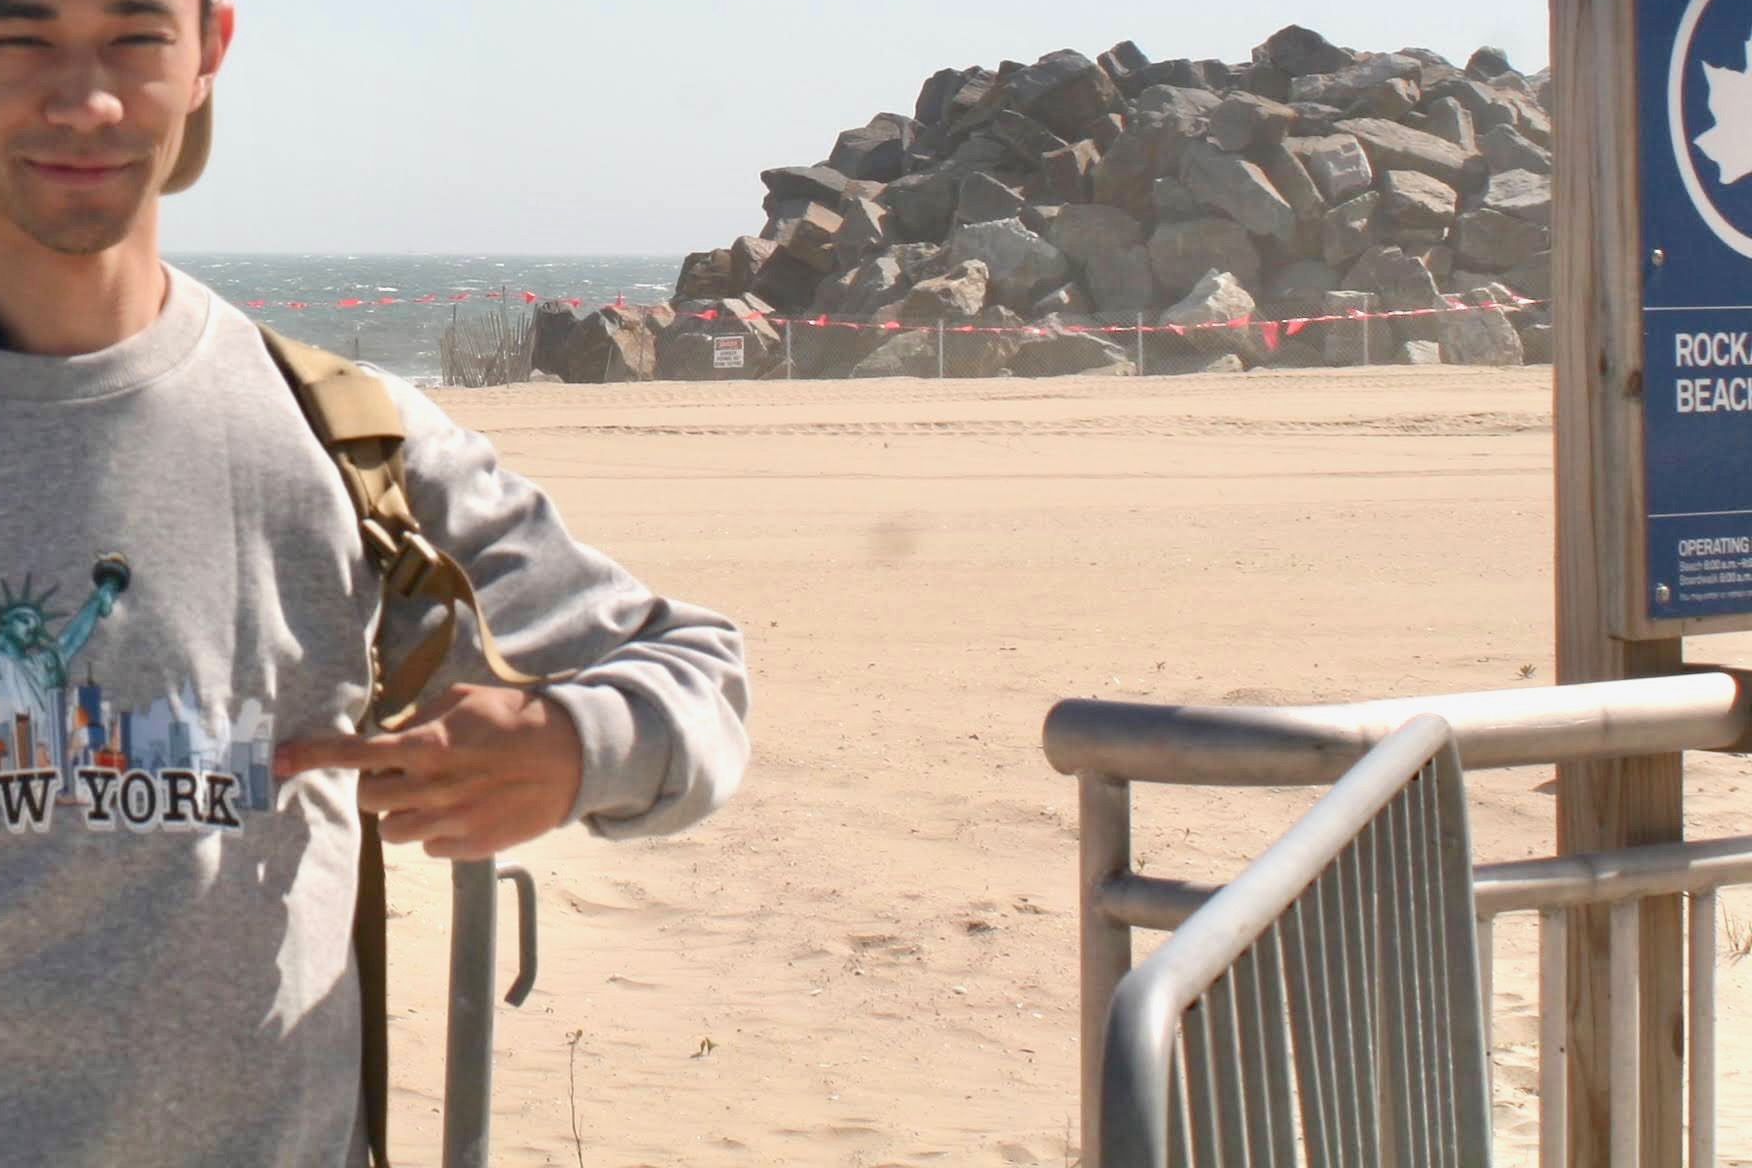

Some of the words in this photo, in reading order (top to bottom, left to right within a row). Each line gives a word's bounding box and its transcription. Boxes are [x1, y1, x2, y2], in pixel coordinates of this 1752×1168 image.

[1675, 331, 1752, 367] ROCK
[1676, 376, 1752, 412] BEAC
[1678, 536, 1750, 557] OPERATING
[78, 769, 241, 830] YORK
